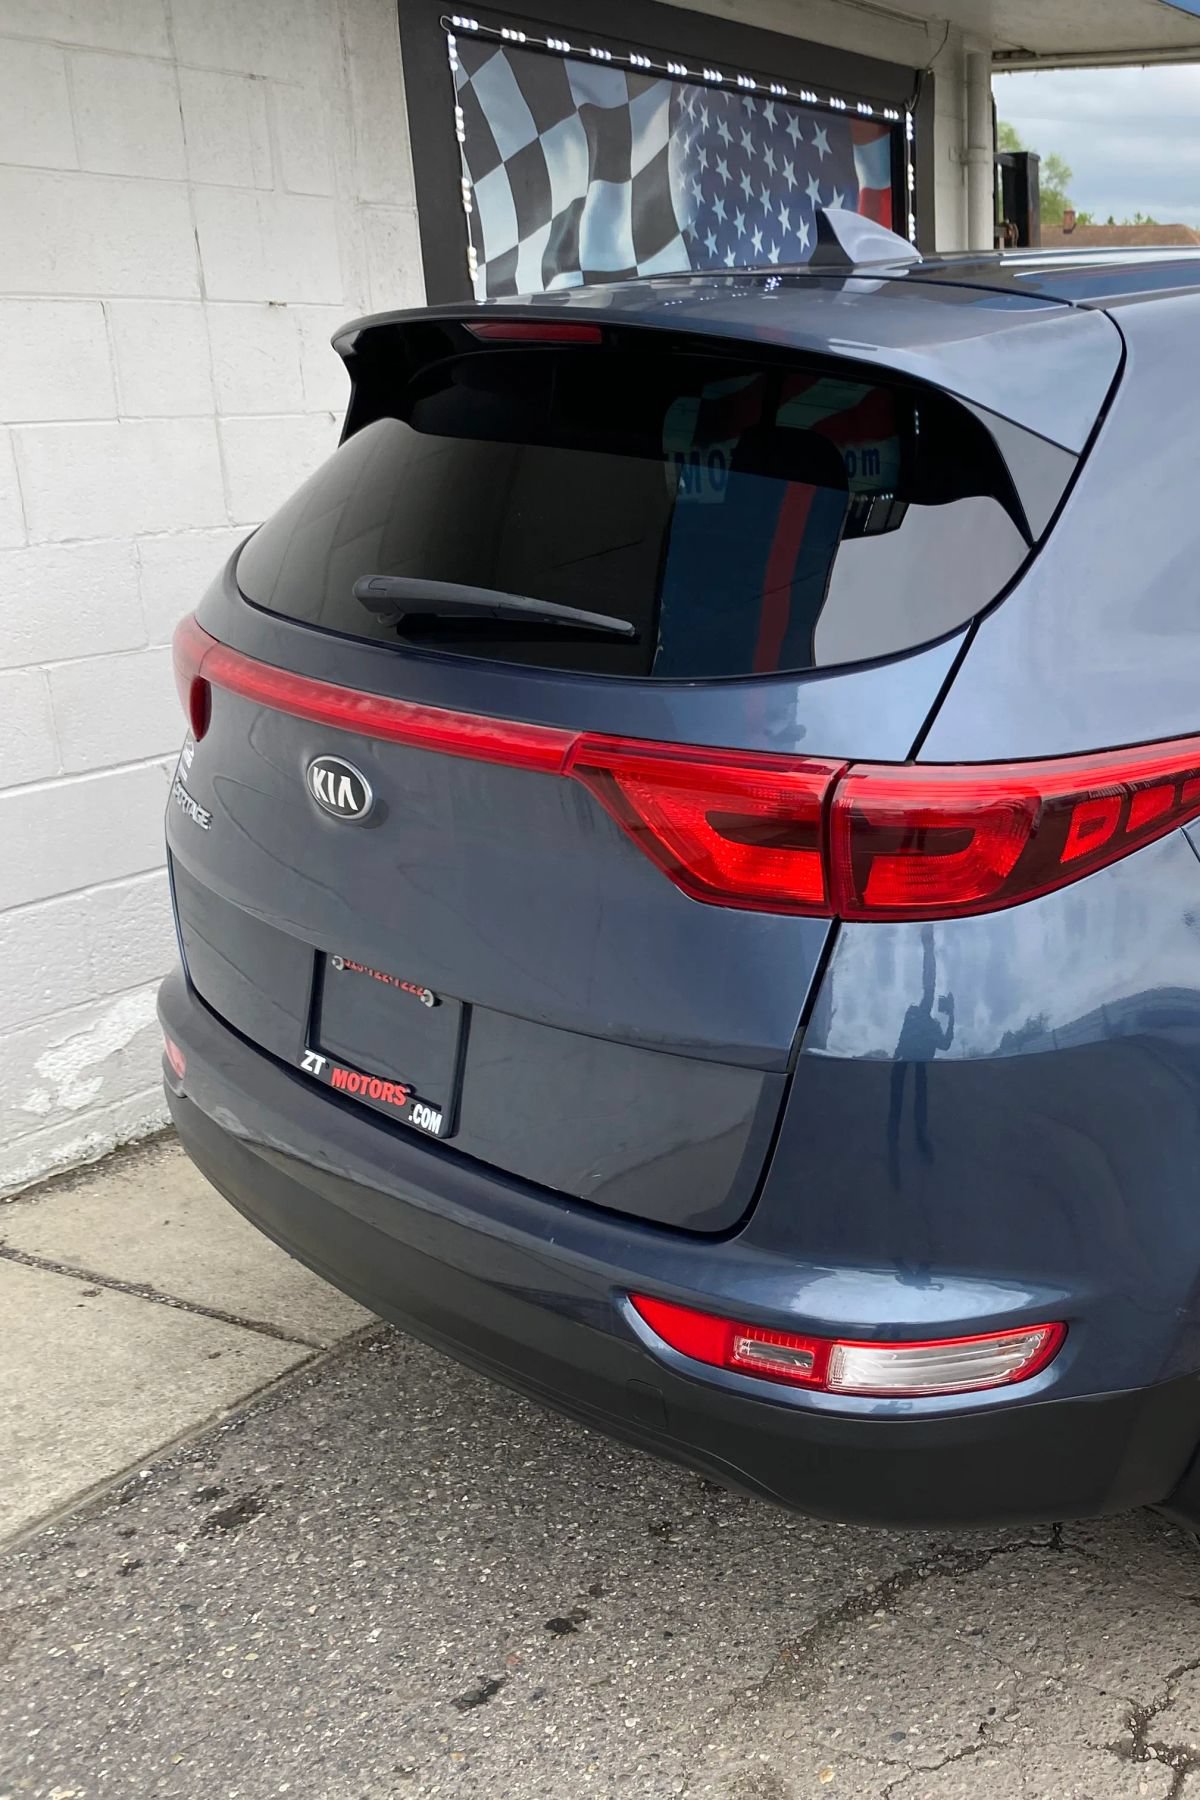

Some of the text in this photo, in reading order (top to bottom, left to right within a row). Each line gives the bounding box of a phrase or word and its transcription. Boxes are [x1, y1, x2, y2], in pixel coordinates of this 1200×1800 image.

[313, 766, 359, 811] KIA
[300, 1049, 443, 1135] ZT MOTORS .COM
